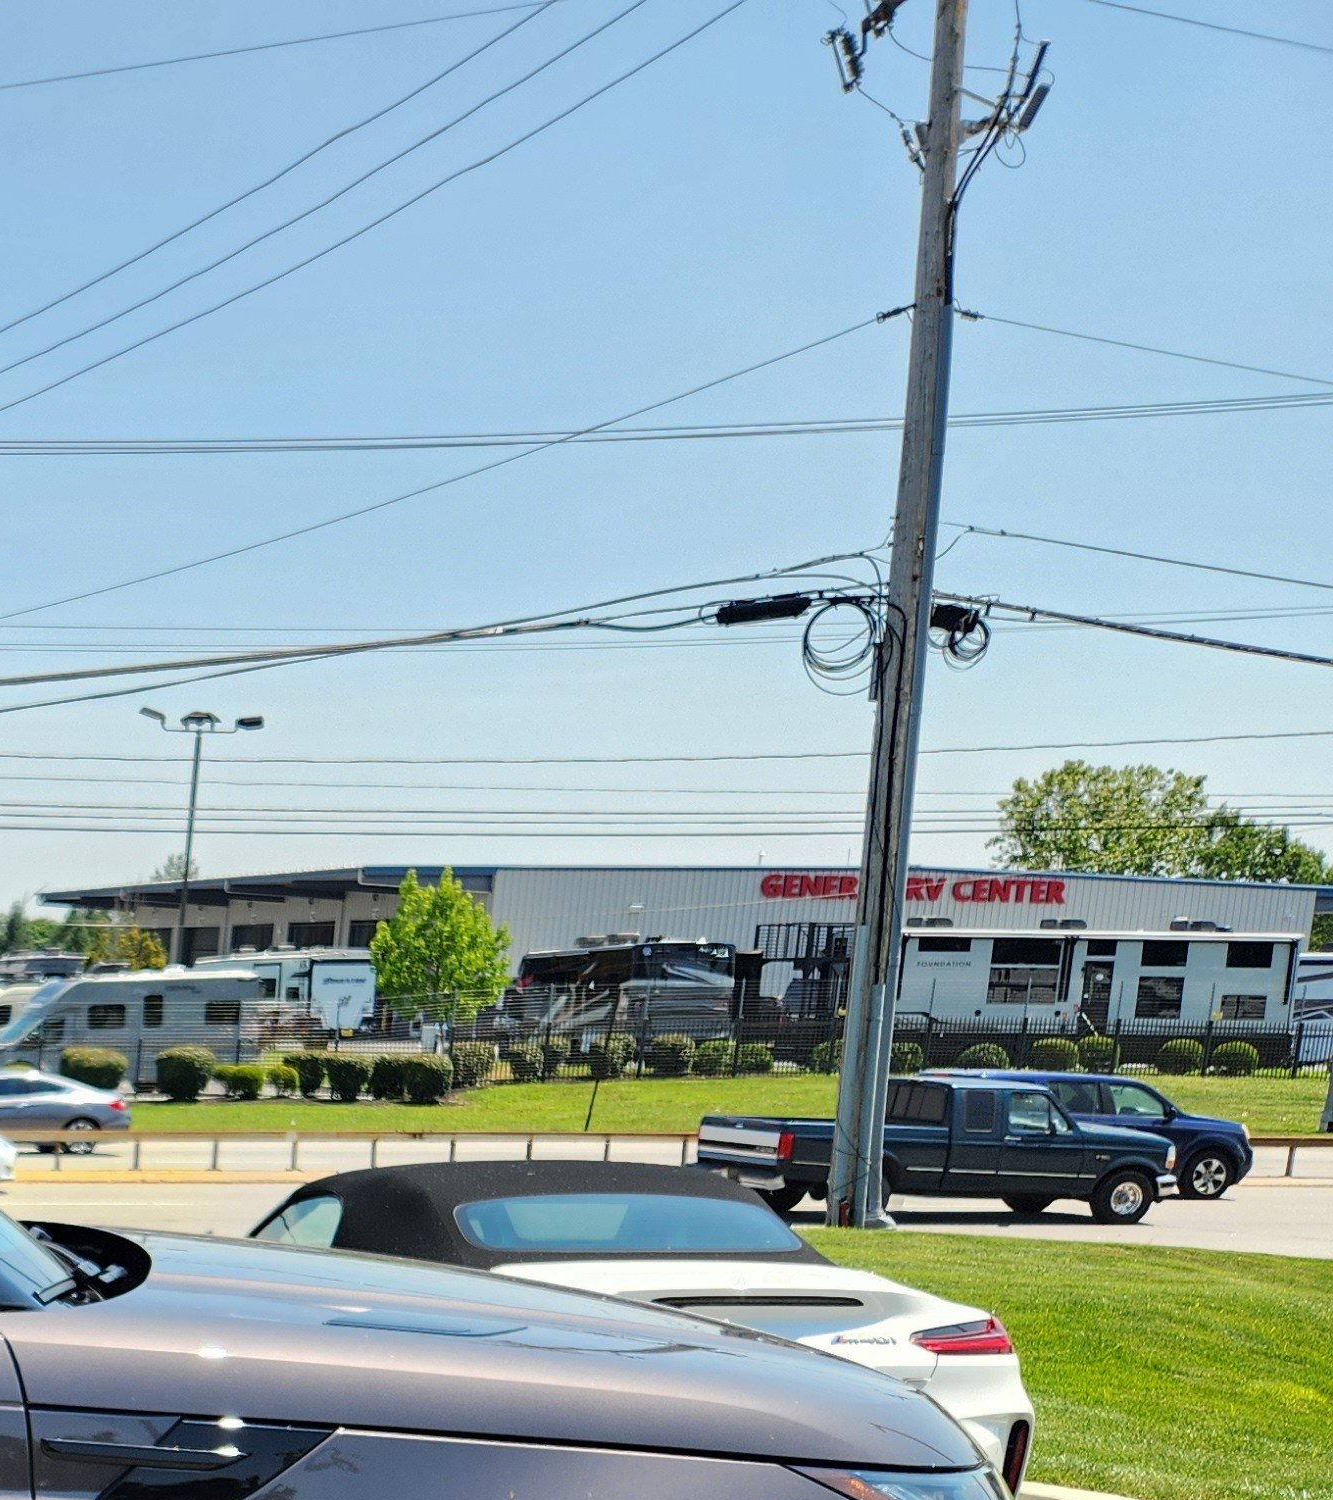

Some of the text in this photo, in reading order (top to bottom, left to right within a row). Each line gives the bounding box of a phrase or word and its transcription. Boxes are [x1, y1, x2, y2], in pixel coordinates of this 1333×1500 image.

[761, 874, 1065, 904] GENER RV CENTER
